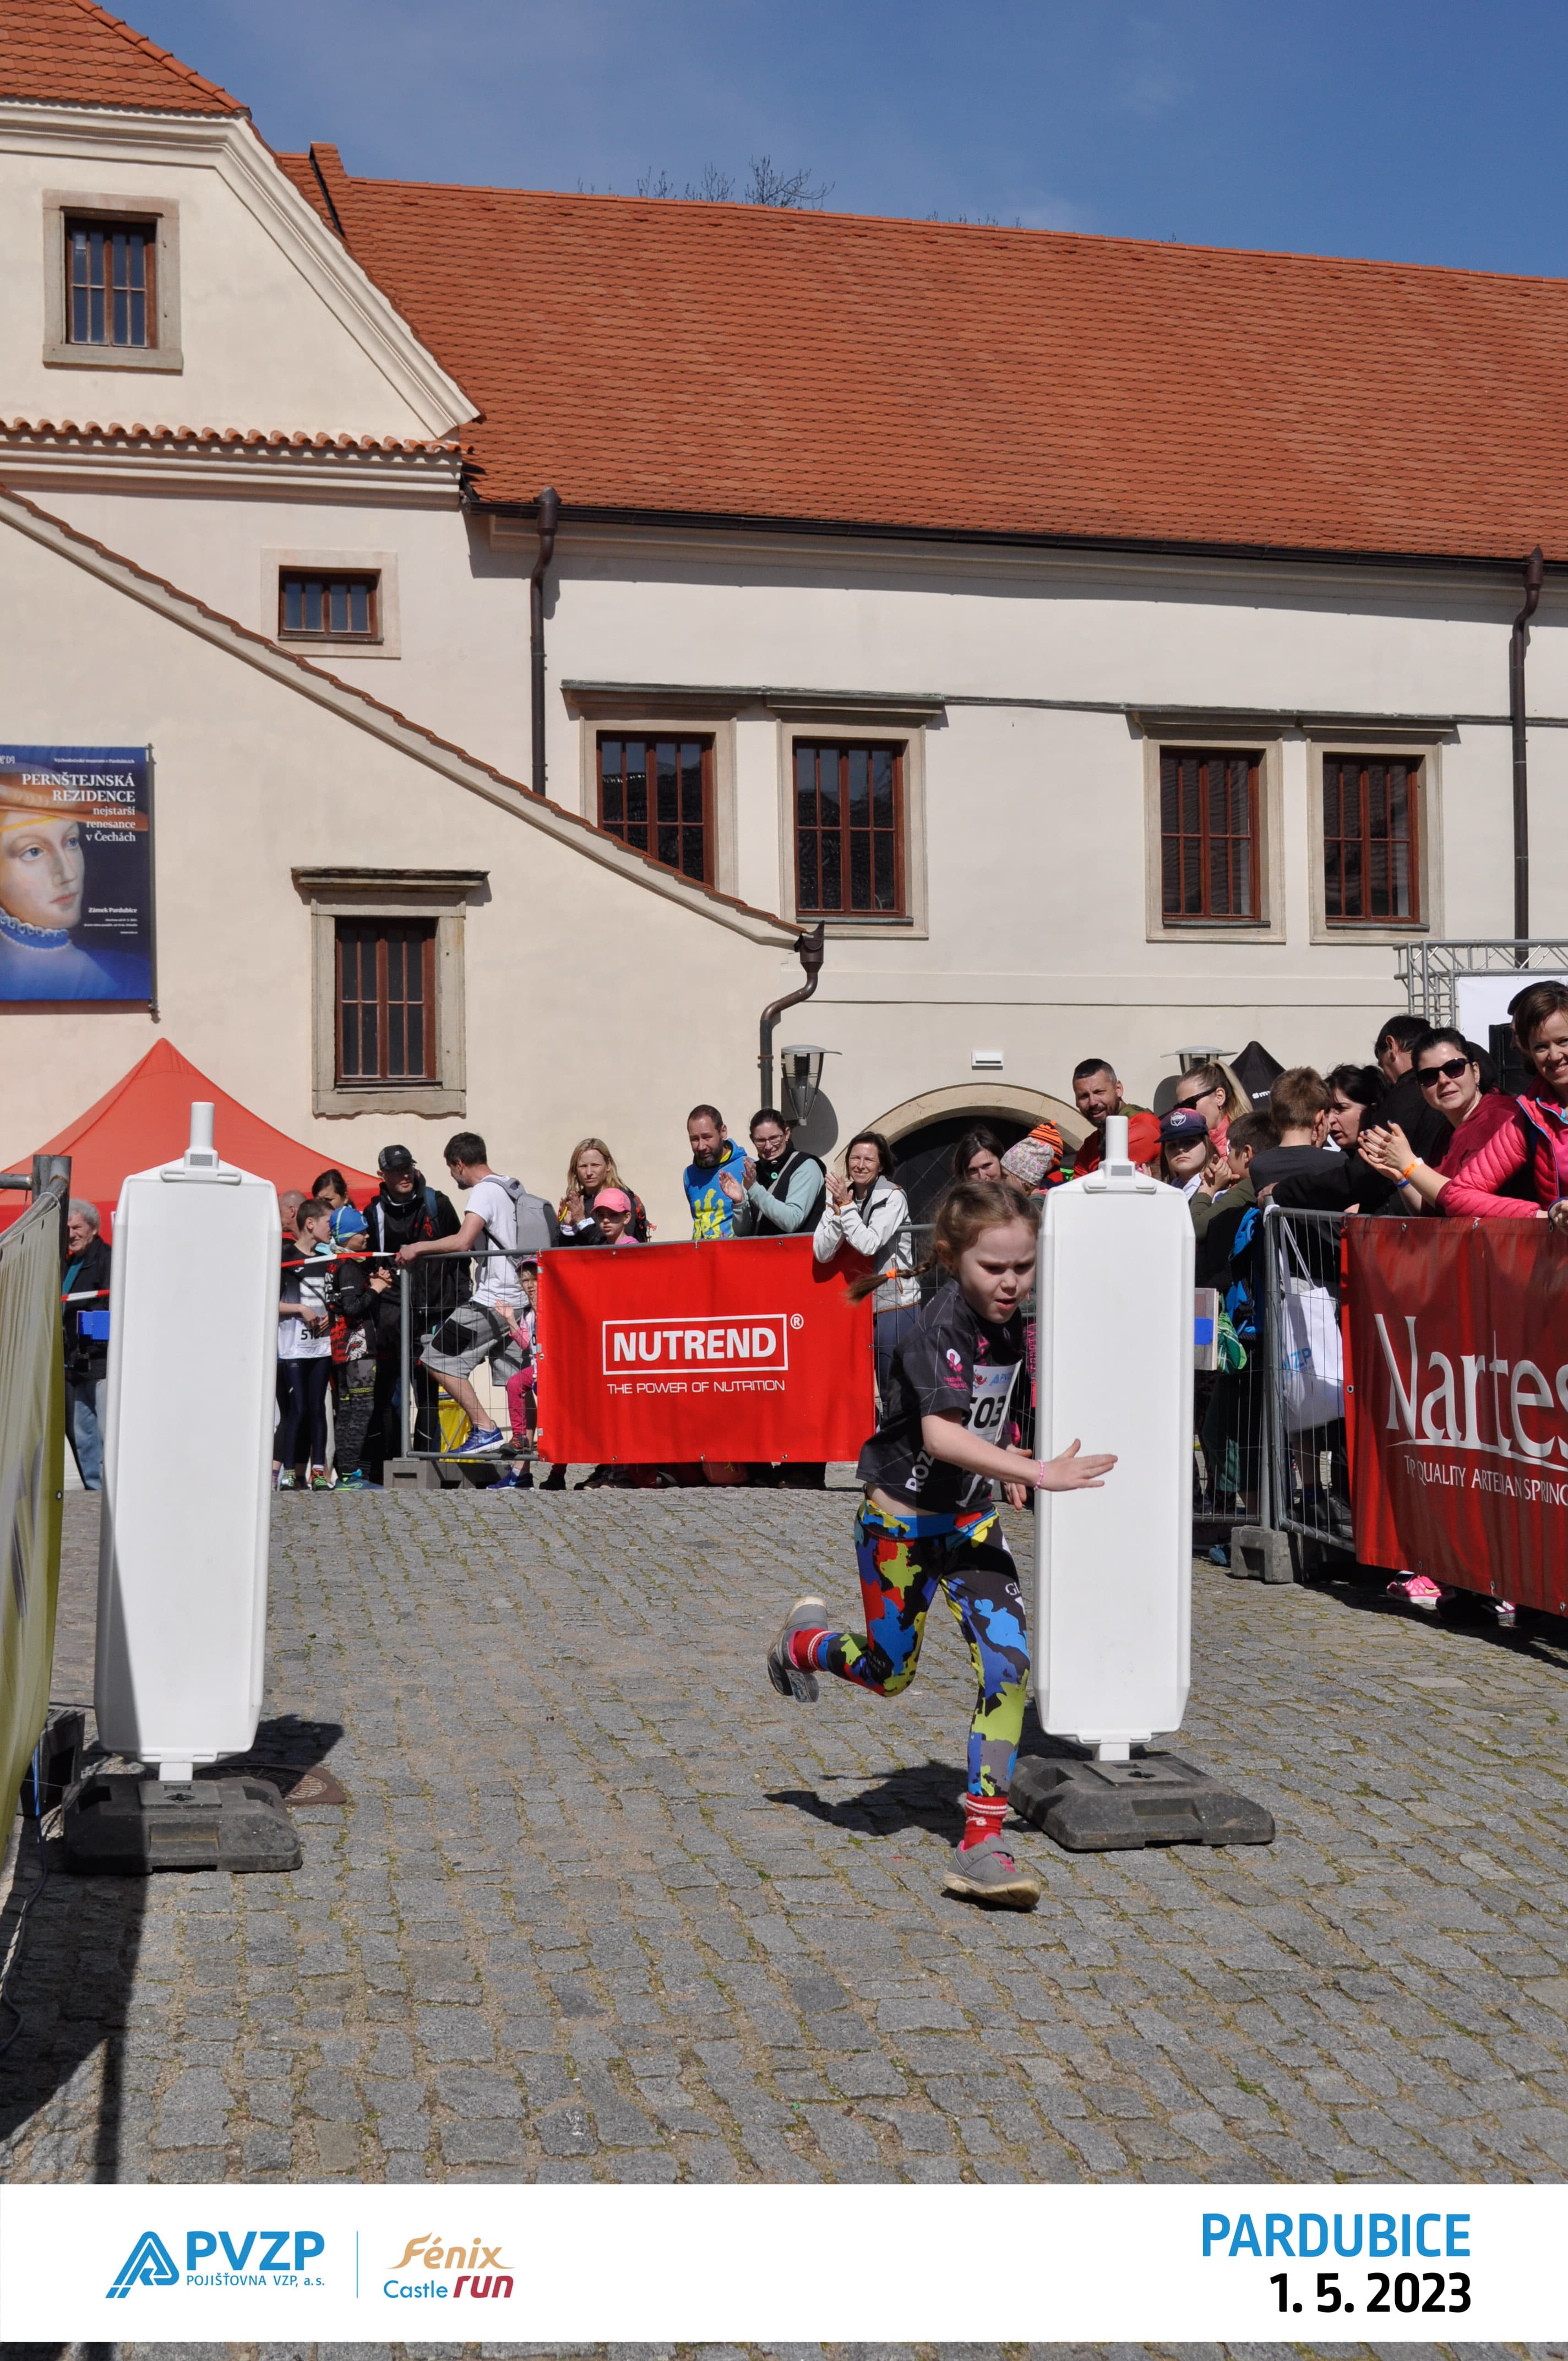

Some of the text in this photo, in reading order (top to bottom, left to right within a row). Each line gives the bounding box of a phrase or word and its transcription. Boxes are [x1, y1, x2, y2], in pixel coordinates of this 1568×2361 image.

[22, 772, 135, 786] PERNŠTEJNSKÁ
[53, 790, 135, 802] REZIDENCE
[93, 806, 135, 817] nejstarší
[95, 830, 135, 842] Čechách
[614, 1328, 776, 1362] NUTREND
[607, 1380, 785, 1394] THE POWER OF NUTRITION
[1417, 1462, 1466, 1487] QUALITY
